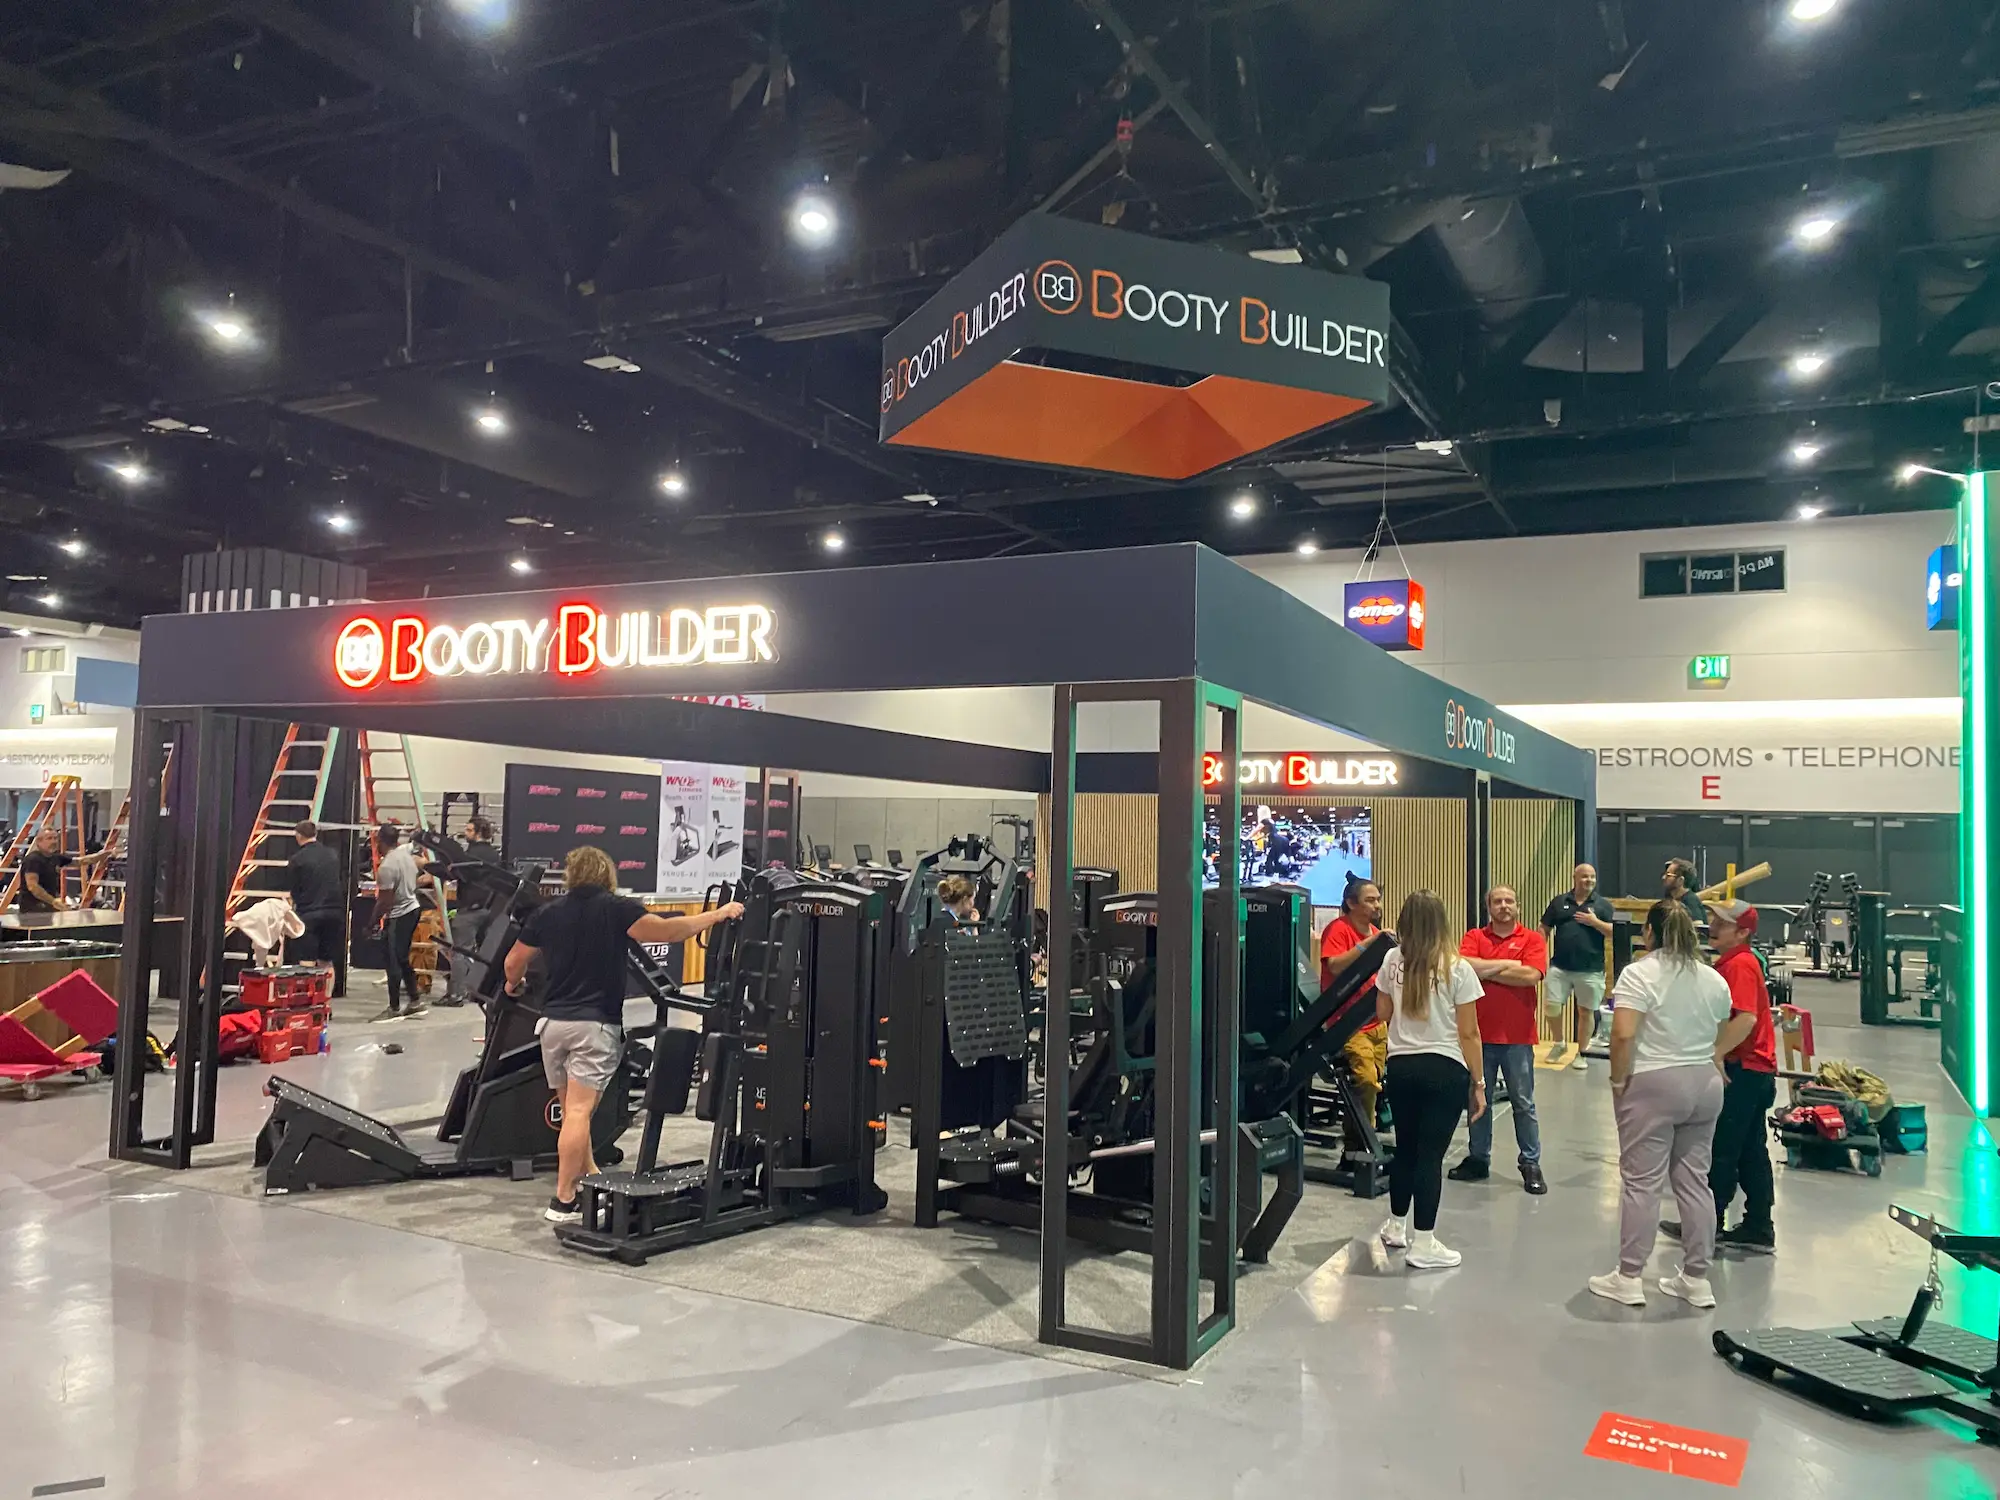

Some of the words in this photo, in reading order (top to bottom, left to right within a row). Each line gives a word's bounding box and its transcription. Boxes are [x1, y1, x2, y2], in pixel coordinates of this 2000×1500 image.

[1090, 268, 1230, 335] BOOTY
[1240, 297, 1386, 368] BUILDER
[896, 328, 950, 402] BOOTY
[952, 272, 1026, 360] BUILDER
[388, 618, 548, 682] BOOTY
[557, 603, 773, 674] BUILDER
[1694, 655, 1730, 678] EXIT
[1457, 705, 1486, 753] BOOTY
[1486, 717, 1516, 765] BUILDER
[1584, 747, 1753, 767] ESTROOMS
[42, 769, 49, 783] D
[1288, 755, 1398, 786] BUILDER
[1701, 775, 1721, 800] E
[814, 902, 844, 916] BUILDER
[1116, 910, 1148, 925] BOOTY
[1610, 1428, 1642, 1441] No
